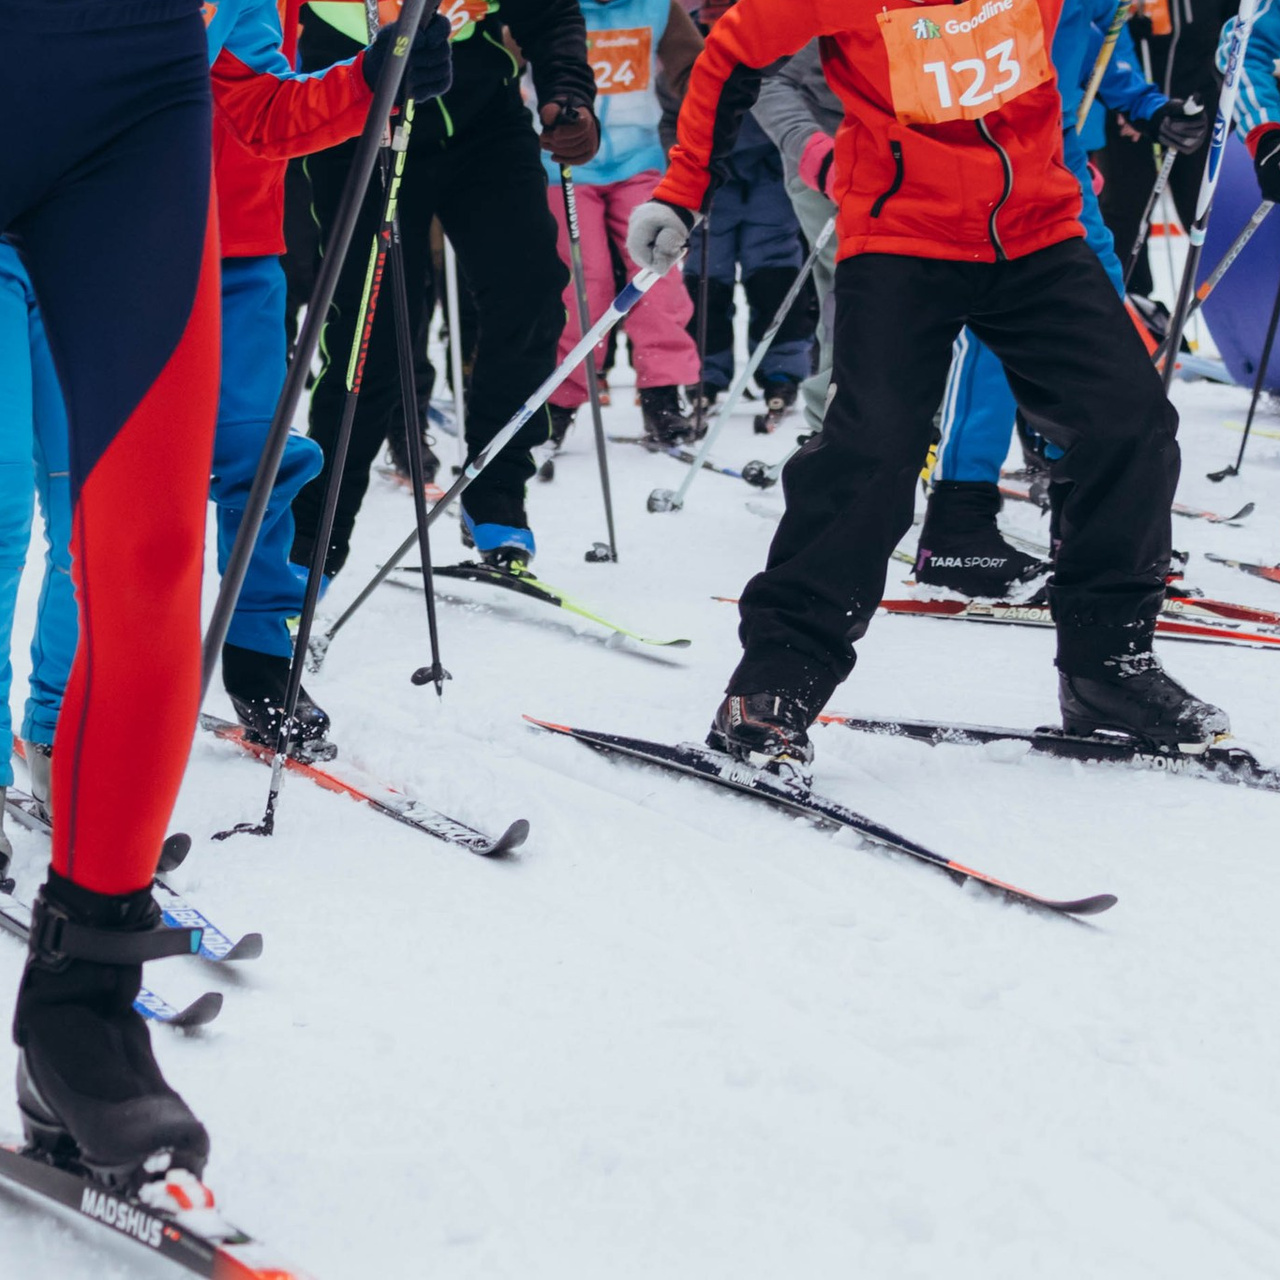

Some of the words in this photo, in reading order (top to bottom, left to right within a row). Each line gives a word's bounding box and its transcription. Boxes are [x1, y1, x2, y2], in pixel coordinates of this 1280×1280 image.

[923, 38, 1021, 108] 123
[930, 557, 963, 568] TARA
[964, 557, 1008, 568] SPORT
[81, 1187, 163, 1248] MADSHUS
